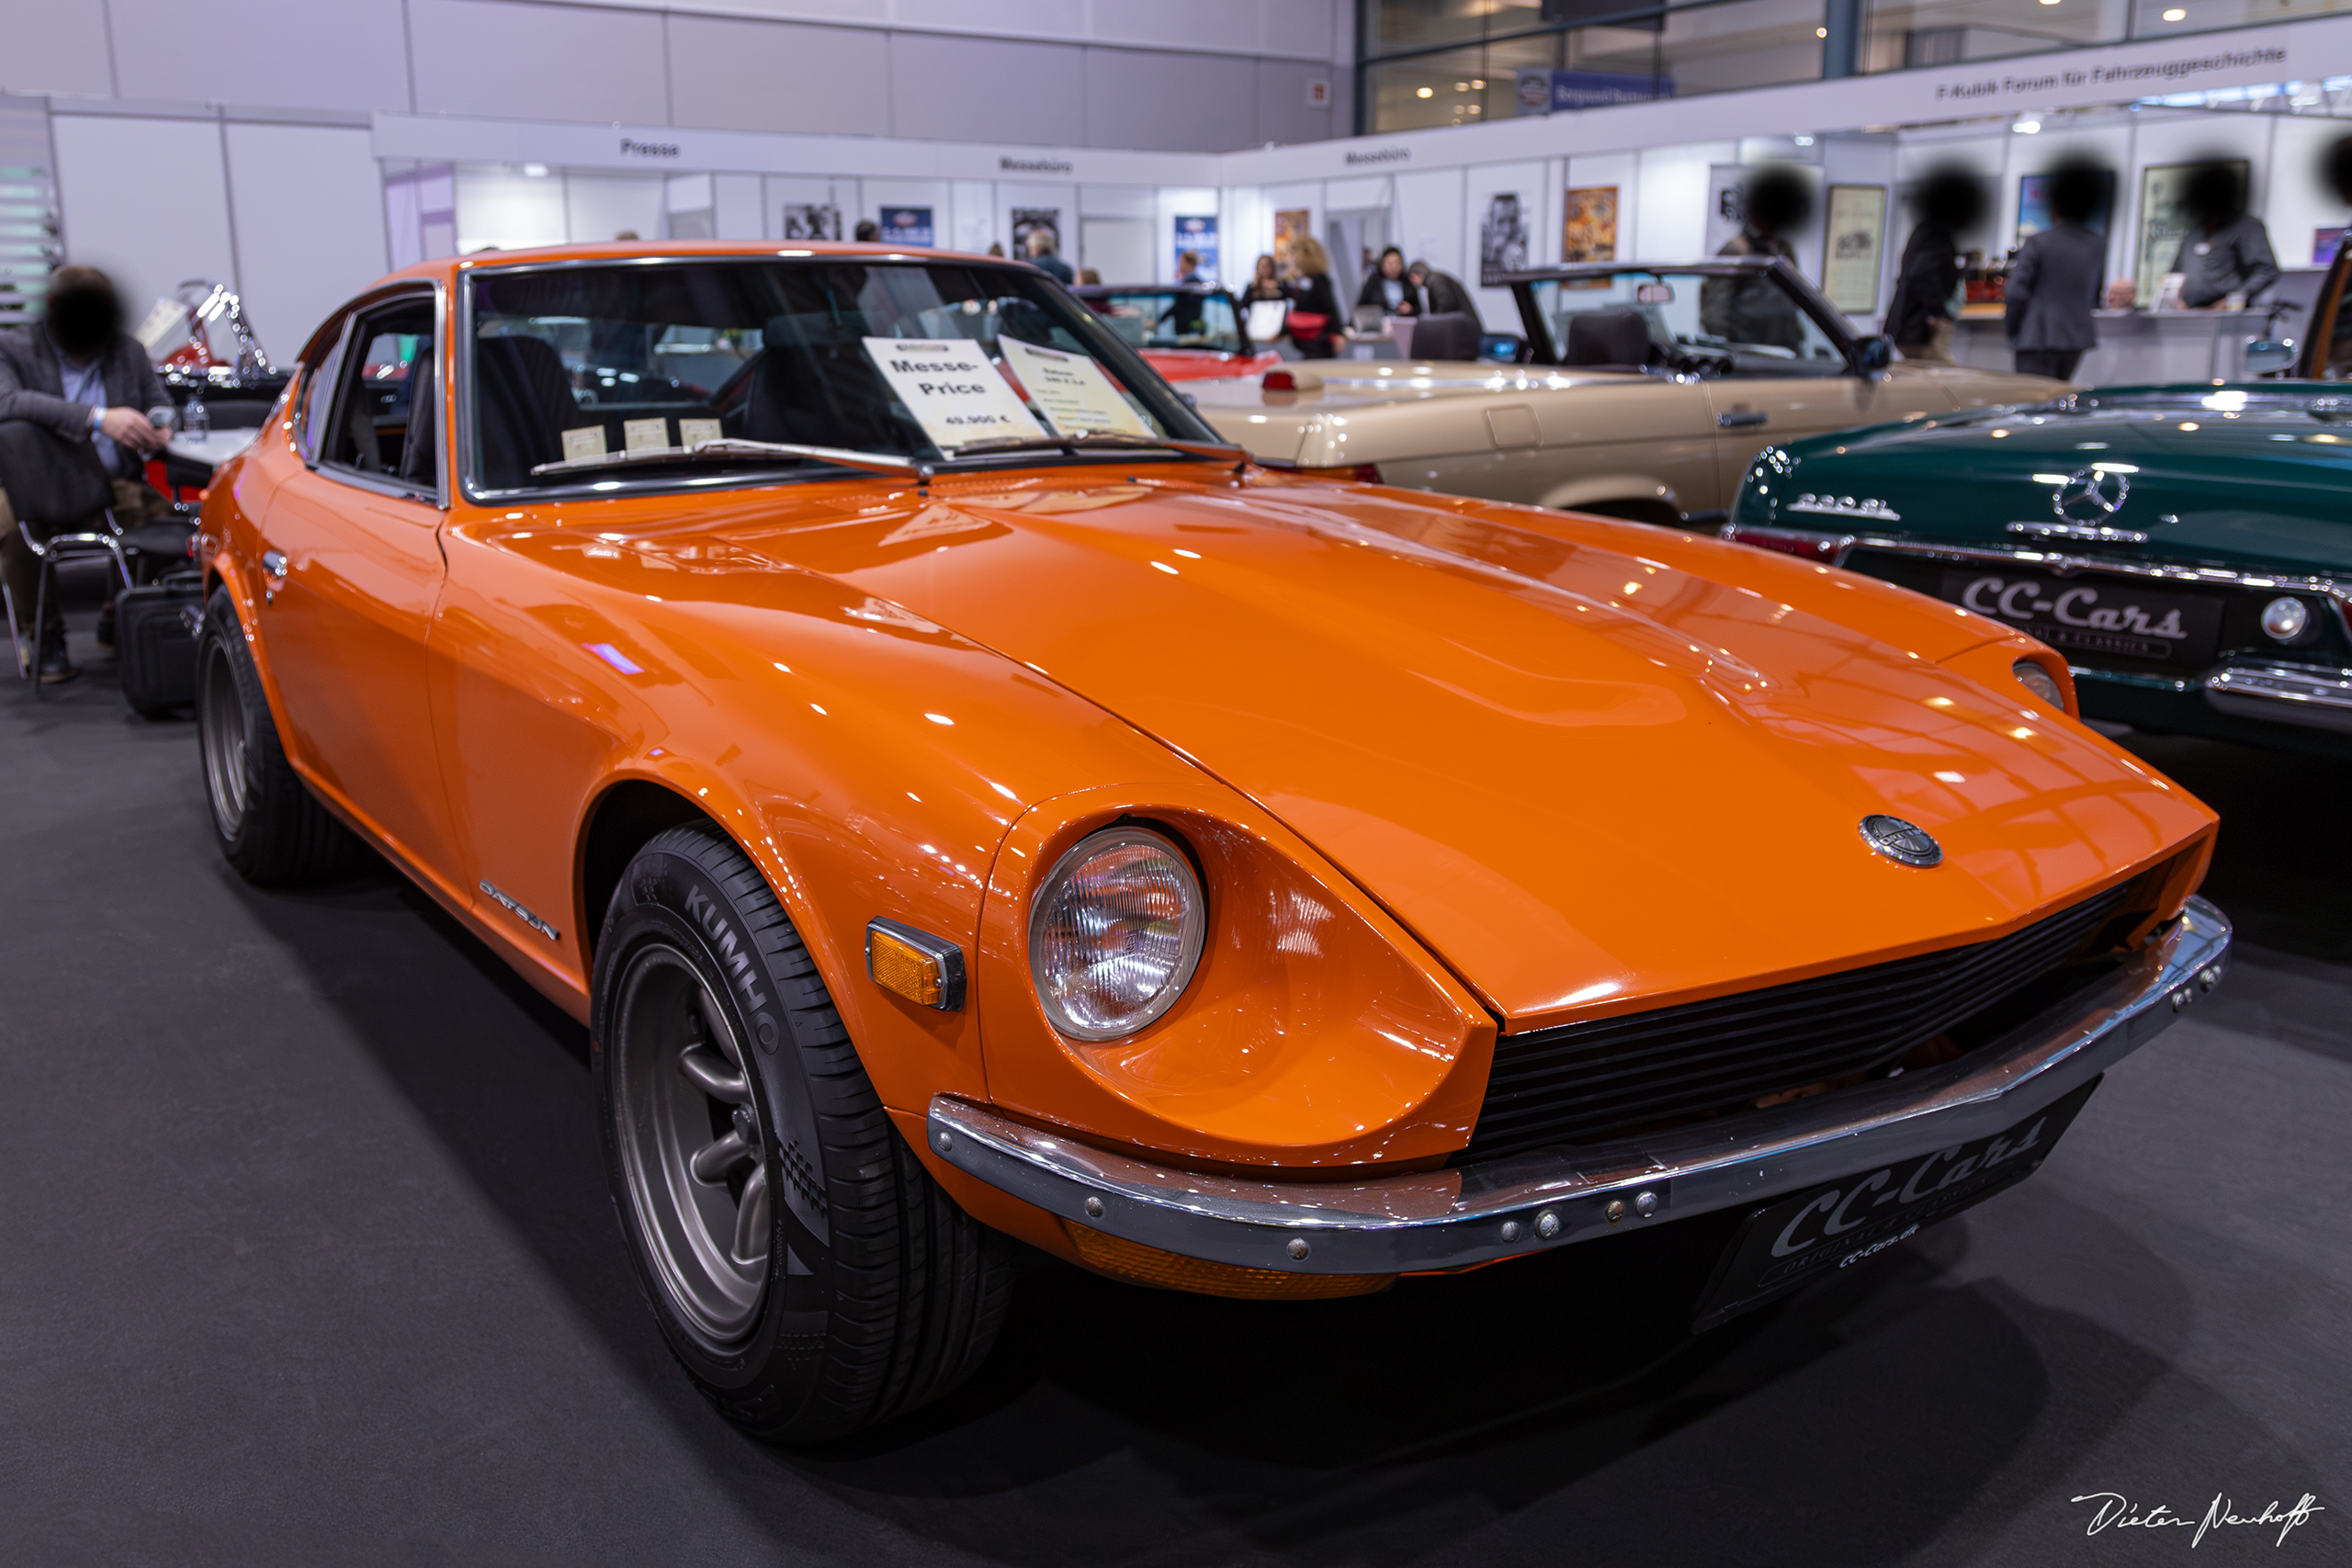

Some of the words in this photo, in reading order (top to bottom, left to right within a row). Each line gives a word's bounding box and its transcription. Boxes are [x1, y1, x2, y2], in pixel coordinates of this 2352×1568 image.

[2003, 74, 2058, 94] Forum
[2062, 71, 2086, 87] für
[2091, 47, 2288, 85] Fahrzeuggeschichte
[620, 139, 681, 159] Presse
[999, 155, 1073, 175] Messebüro
[1344, 147, 1412, 166] Messebüro
[889, 359, 979, 374] Messe-
[918, 381, 987, 396] Price
[1962, 577, 2188, 640] CC-Cars
[480, 878, 560, 941] DATSUN
[684, 885, 780, 1055] KUMHO
[1771, 1116, 2048, 1258] CC-Cars
